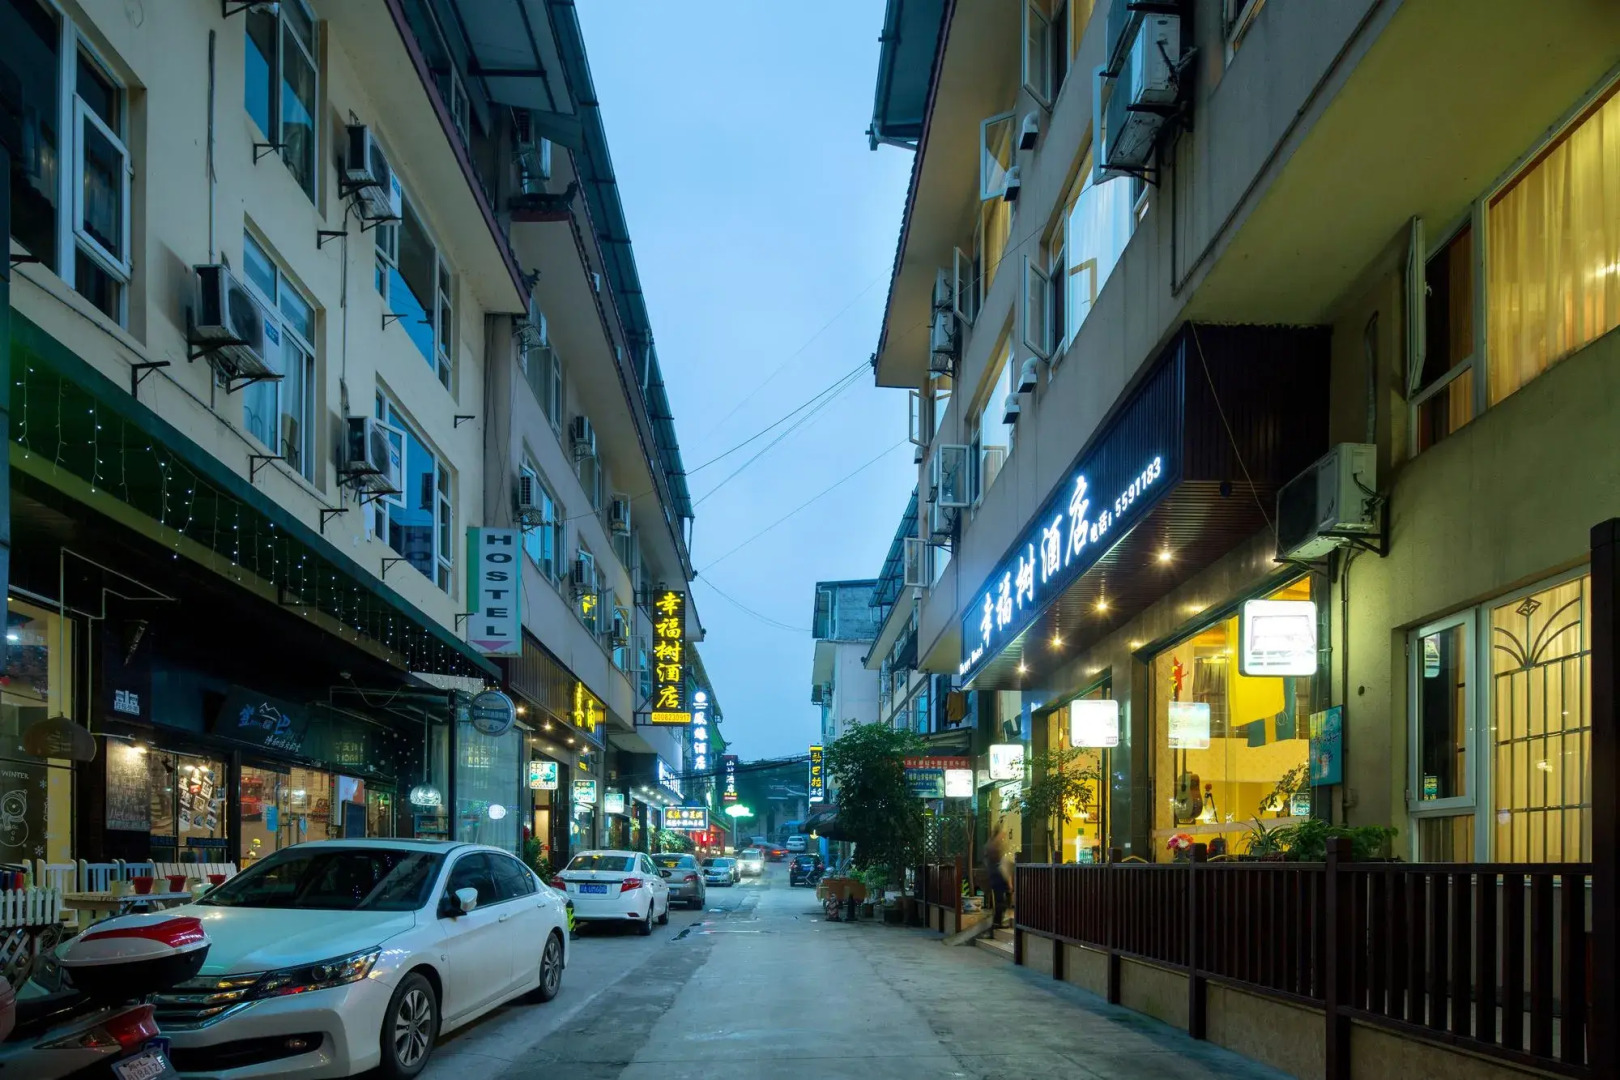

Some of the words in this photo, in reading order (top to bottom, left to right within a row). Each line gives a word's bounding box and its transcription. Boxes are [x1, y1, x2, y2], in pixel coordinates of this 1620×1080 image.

[1115, 456, 1161, 518] 5591183
[485, 534, 512, 637] HOSTEL
[980, 475, 1090, 648] 幸福树酒店
[655, 591, 682, 709] 幸福树酒店
[1, 769, 30, 780] WINTER
